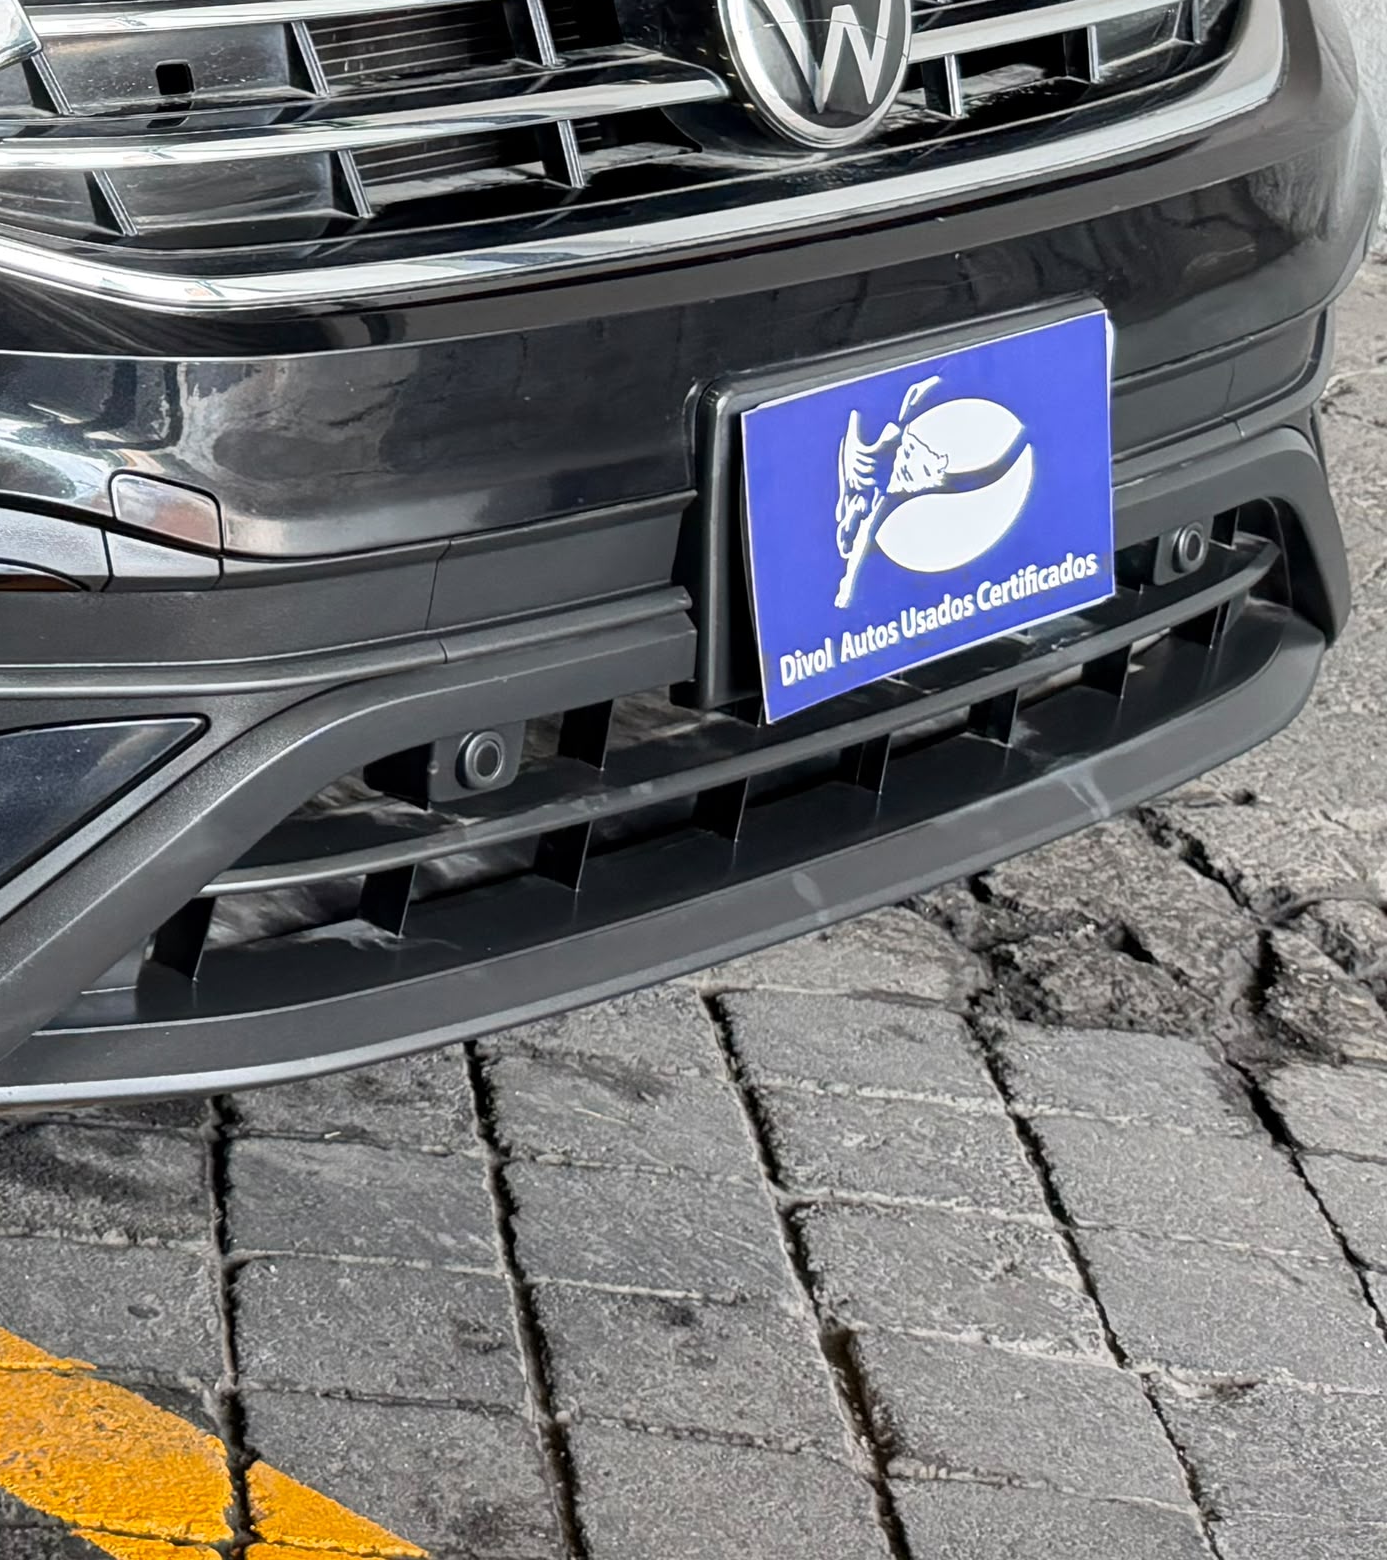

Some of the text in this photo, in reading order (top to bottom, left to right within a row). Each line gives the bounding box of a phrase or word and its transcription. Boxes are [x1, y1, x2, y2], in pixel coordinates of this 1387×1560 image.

[780, 552, 1099, 687] Divol Autos Usados Certificados
